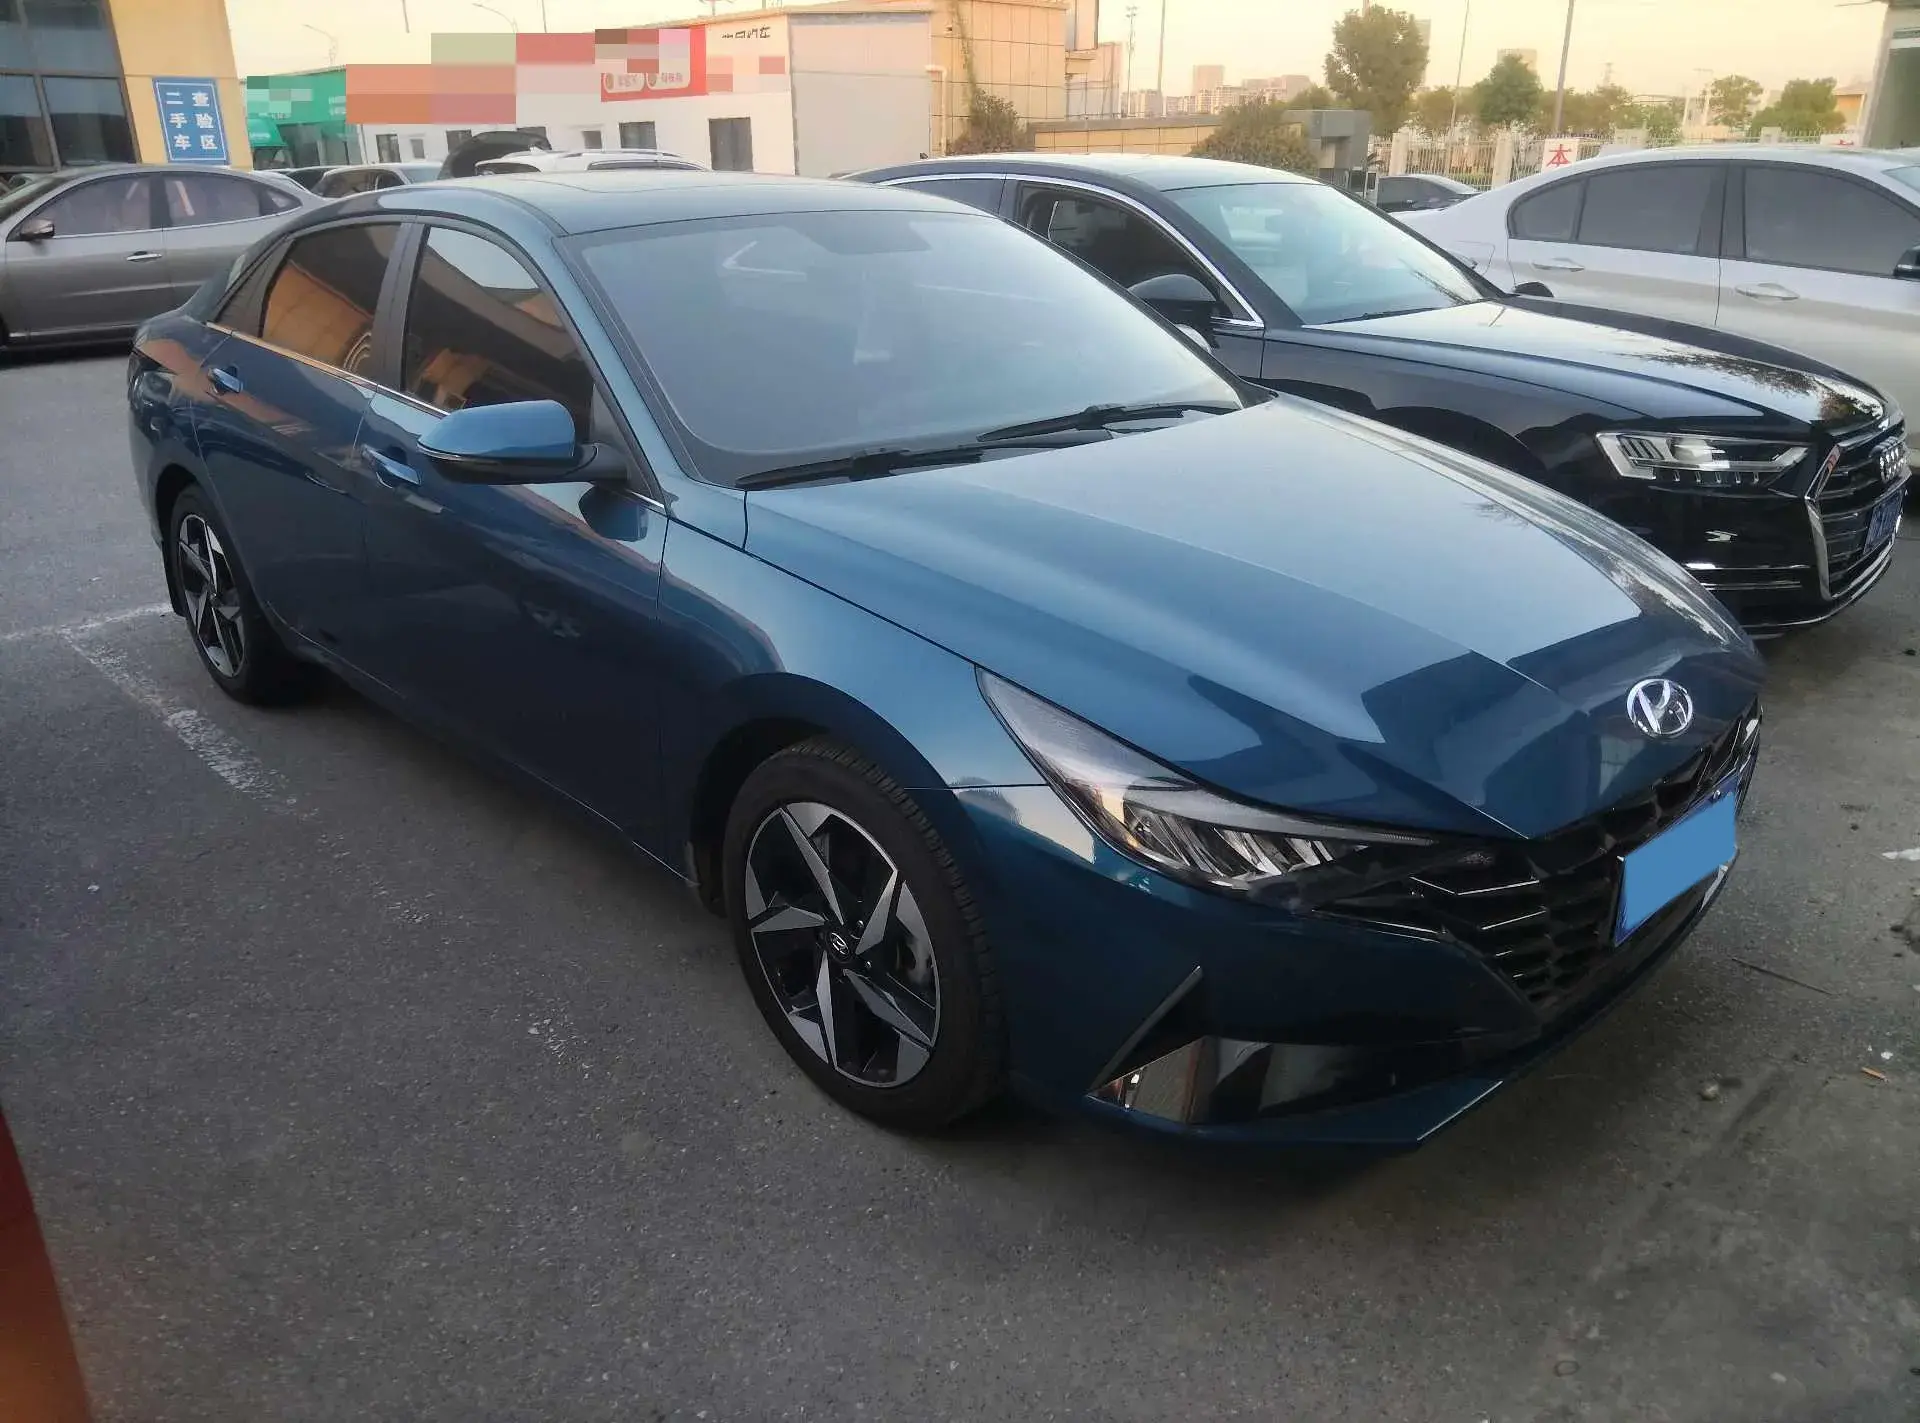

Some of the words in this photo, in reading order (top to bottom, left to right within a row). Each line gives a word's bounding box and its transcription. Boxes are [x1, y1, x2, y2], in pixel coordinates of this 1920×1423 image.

[166, 92, 192, 150] 二手车
[192, 90, 218, 149] 查验区
[1546, 144, 1572, 167] 本
